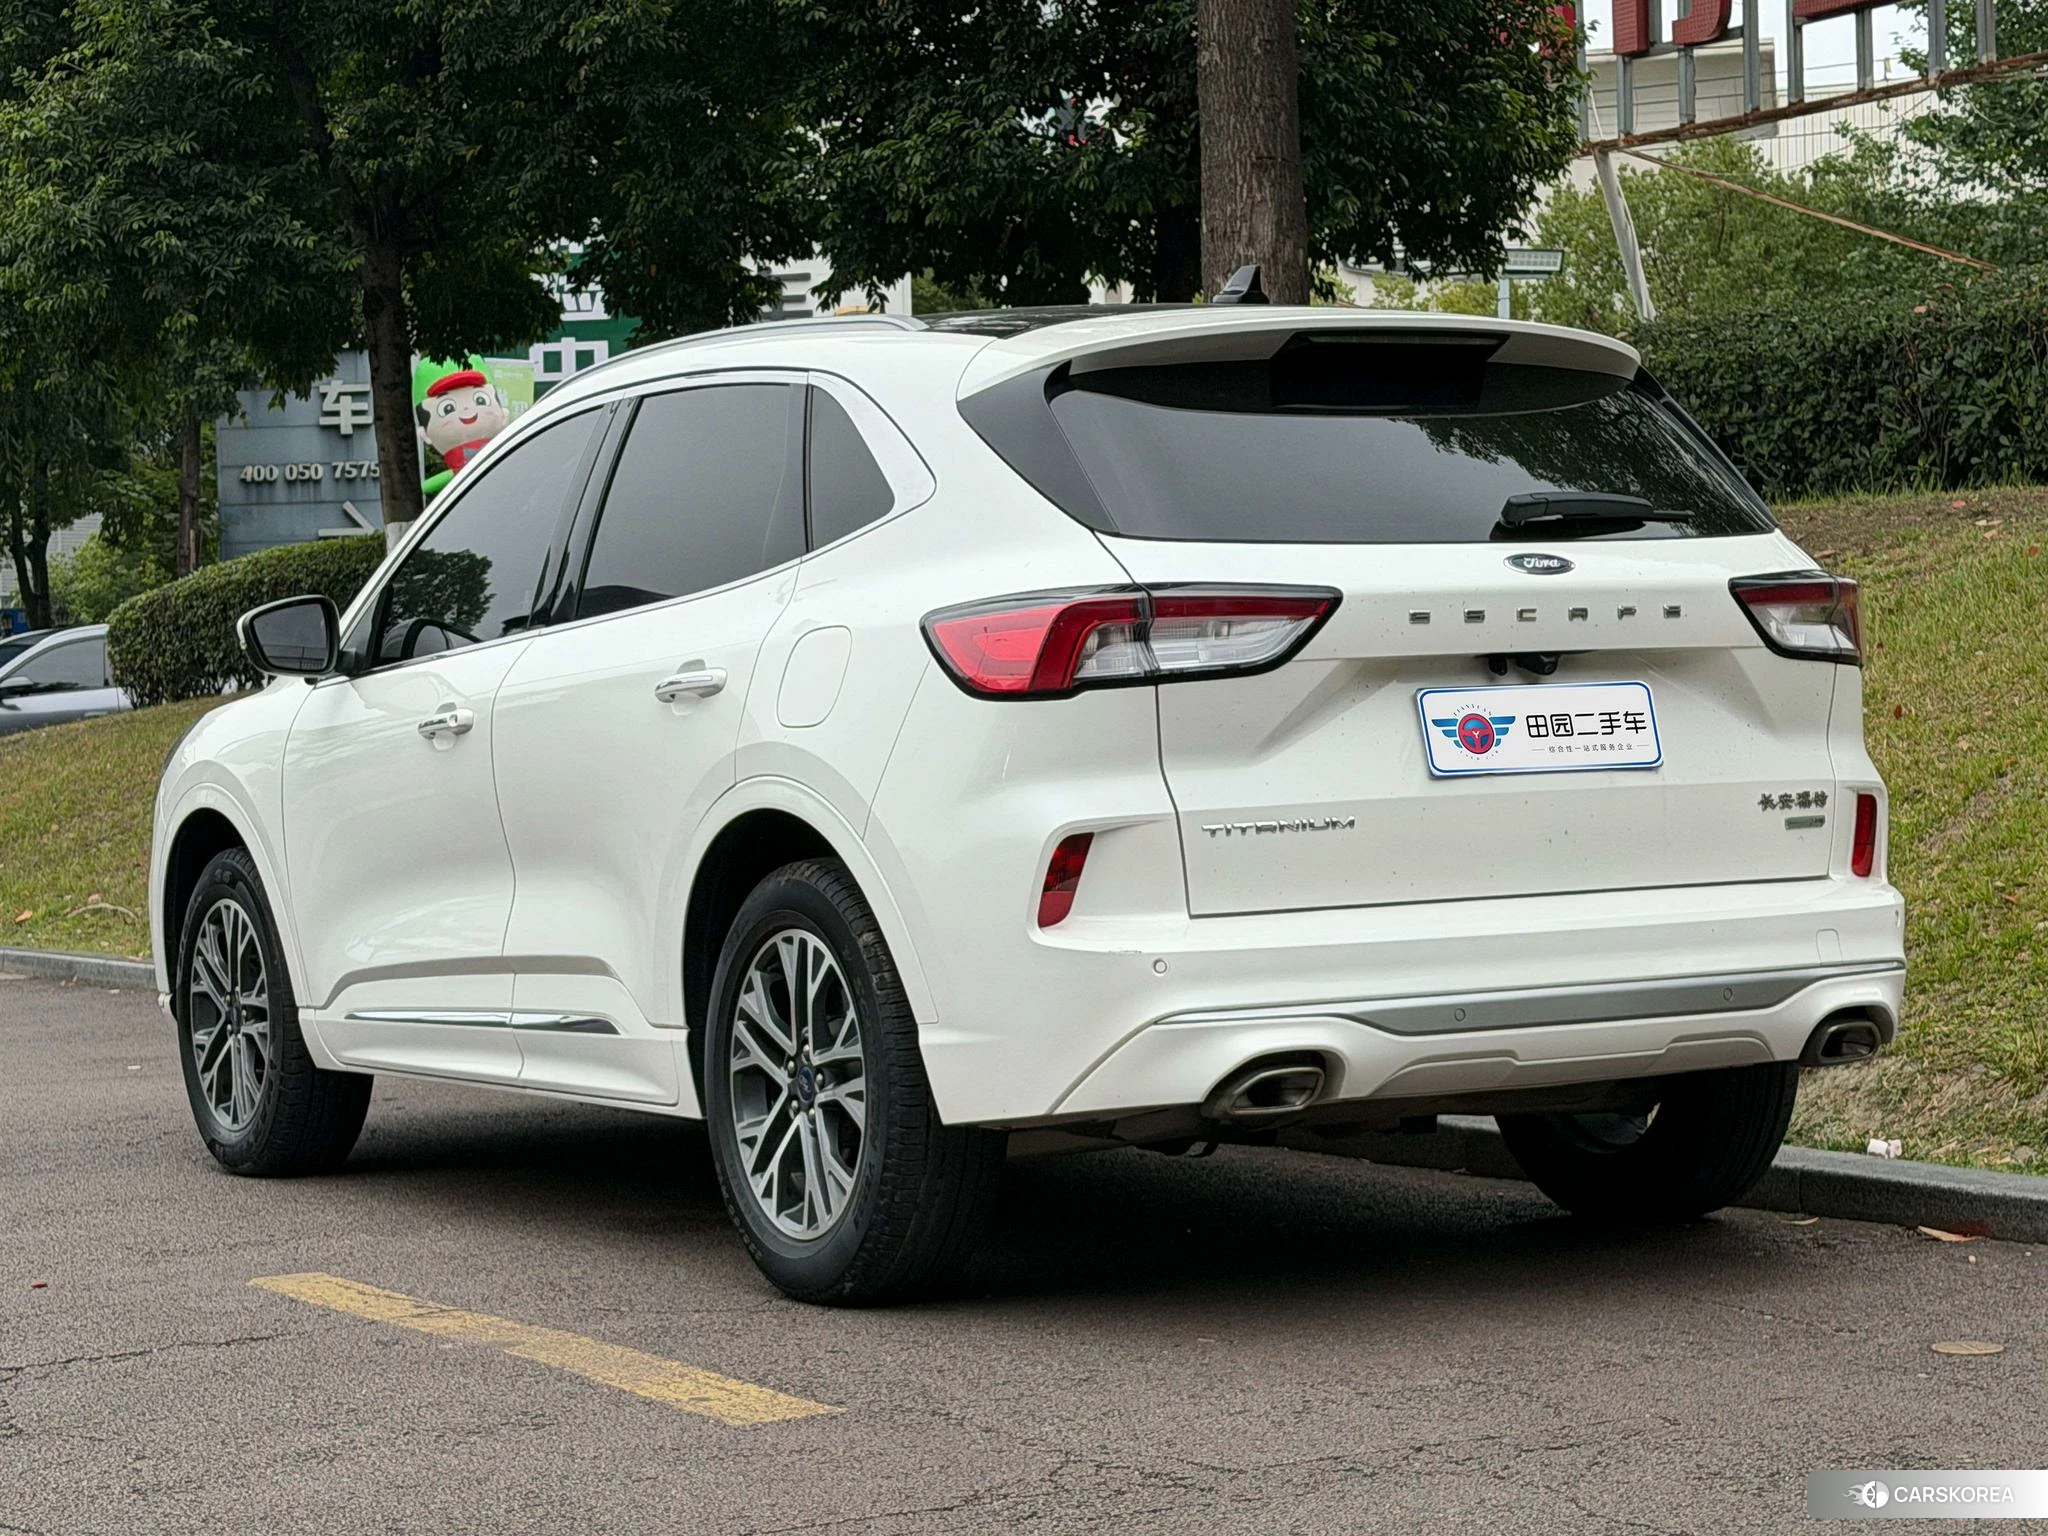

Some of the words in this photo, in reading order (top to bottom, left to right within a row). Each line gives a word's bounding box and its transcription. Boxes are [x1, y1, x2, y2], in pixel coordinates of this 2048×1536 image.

[318, 379, 374, 436] 车
[240, 464, 279, 483] 400
[285, 463, 324, 481] 050
[332, 461, 380, 480] 7575
[1408, 603, 1682, 625] ESCAPE
[1526, 711, 1647, 738] 田园二手车
[1548, 743, 1633, 753] 综合性一站式服务企业
[1202, 815, 1355, 837] TITANIUM
